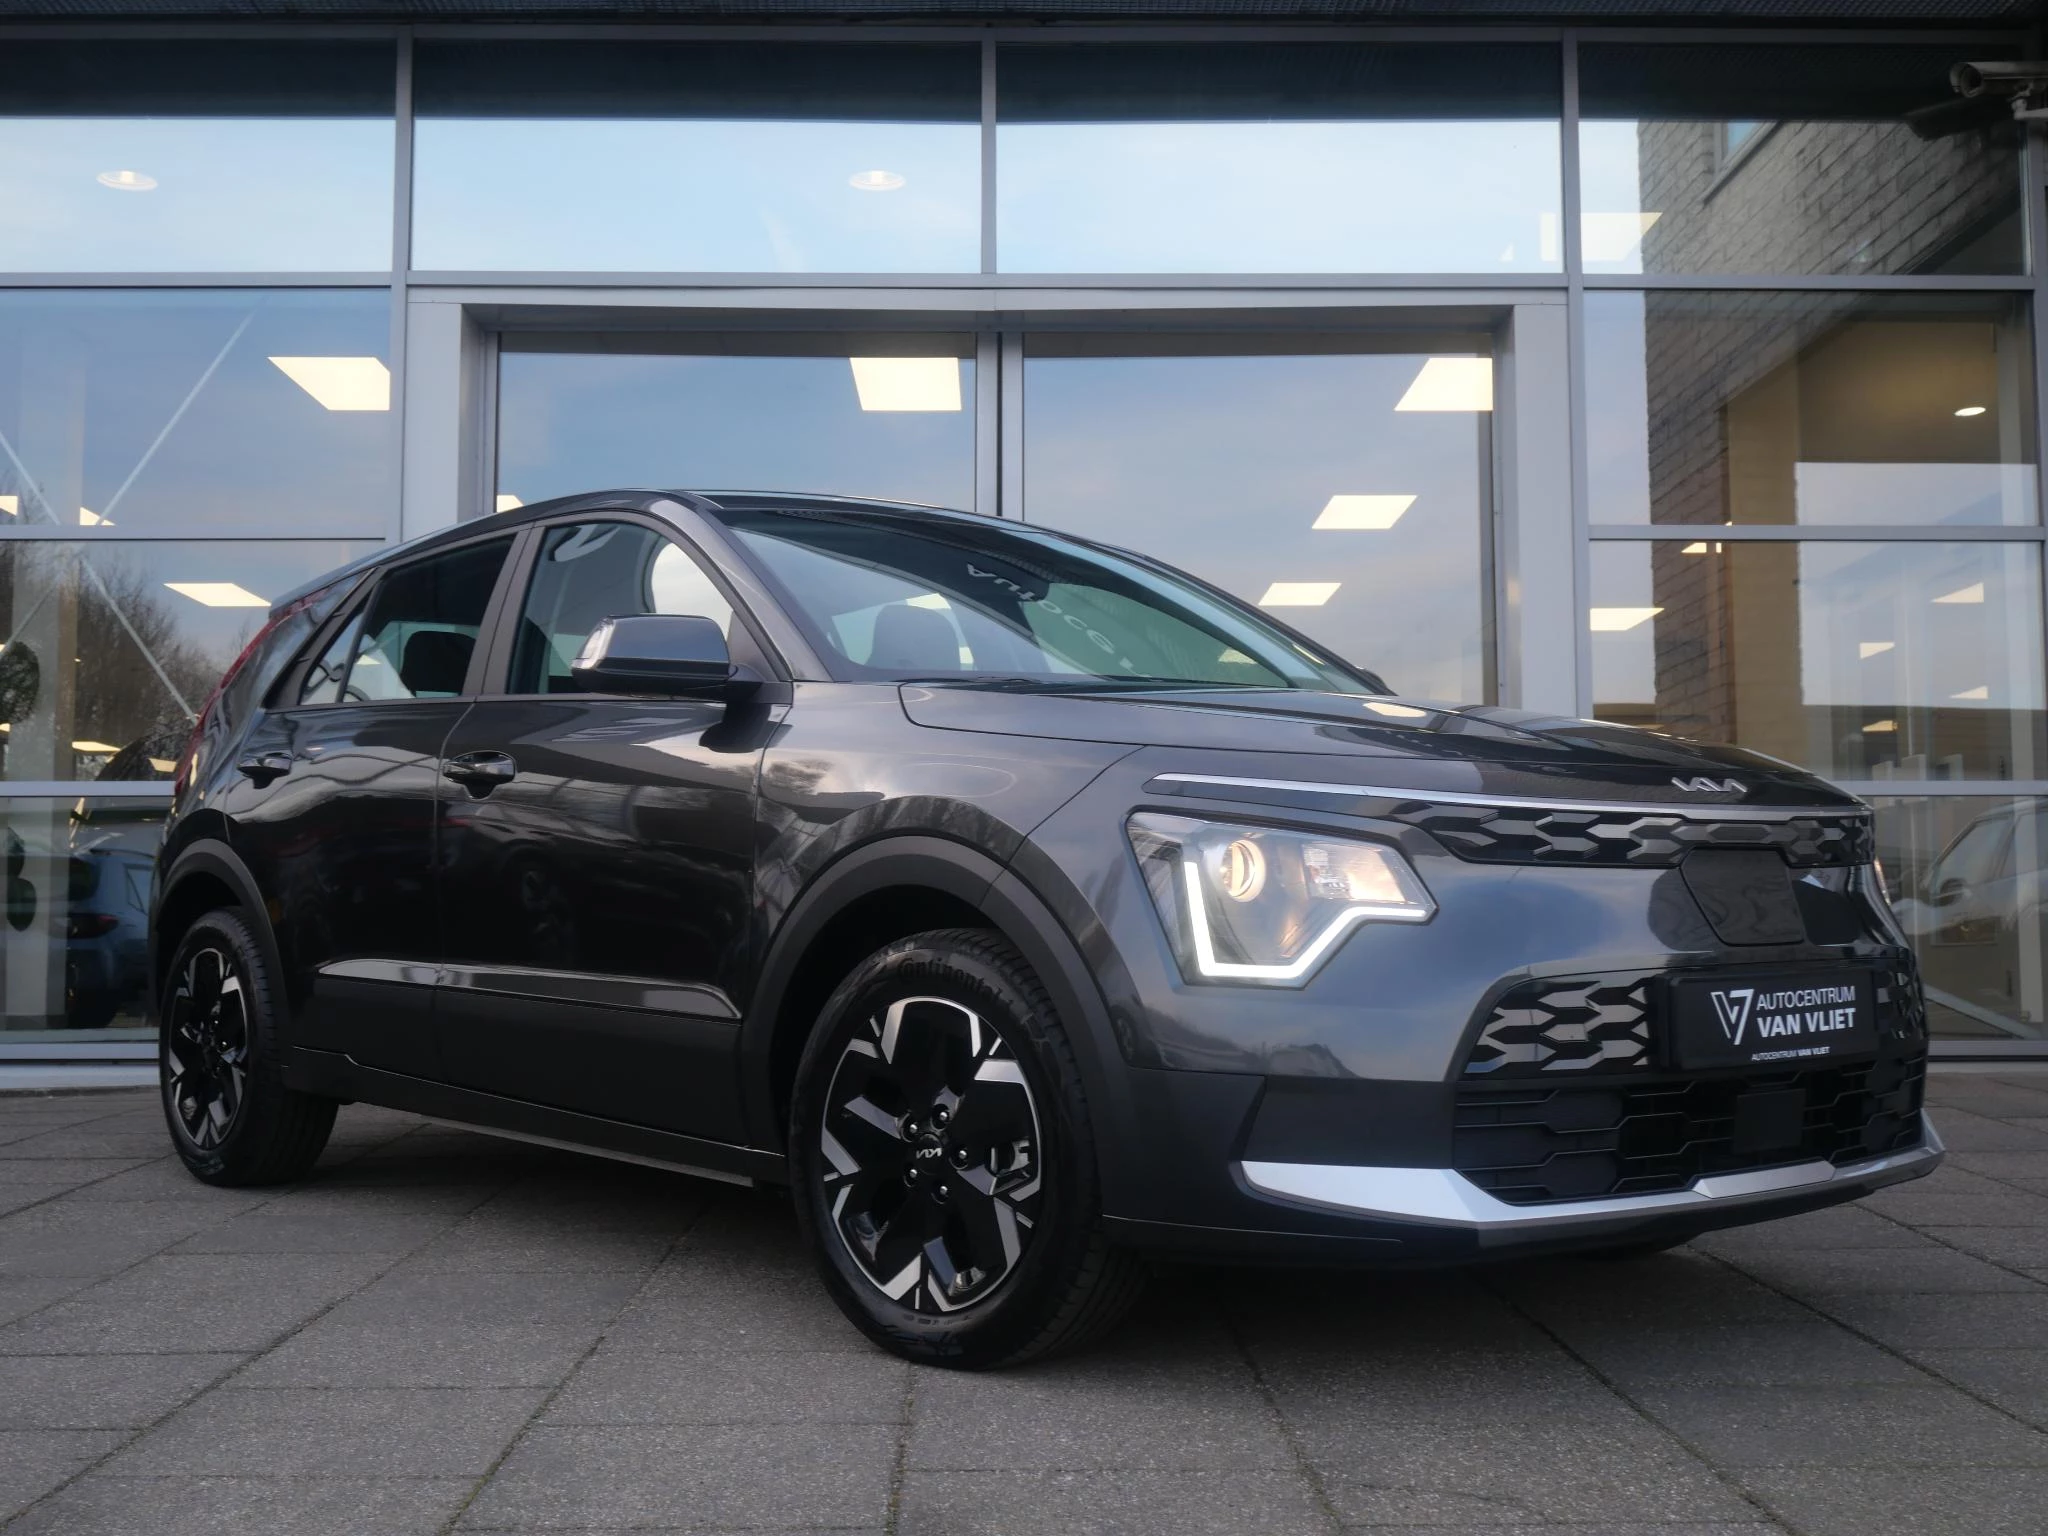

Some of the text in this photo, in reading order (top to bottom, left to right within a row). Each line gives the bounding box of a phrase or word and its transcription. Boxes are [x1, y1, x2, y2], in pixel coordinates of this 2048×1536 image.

[1756, 985, 1856, 1011] AUTOCENTRUM
[1756, 1007, 1857, 1038] VAN VLIET
[1751, 1046, 1831, 1061] AUTOCENTRUM VAN VLIET
